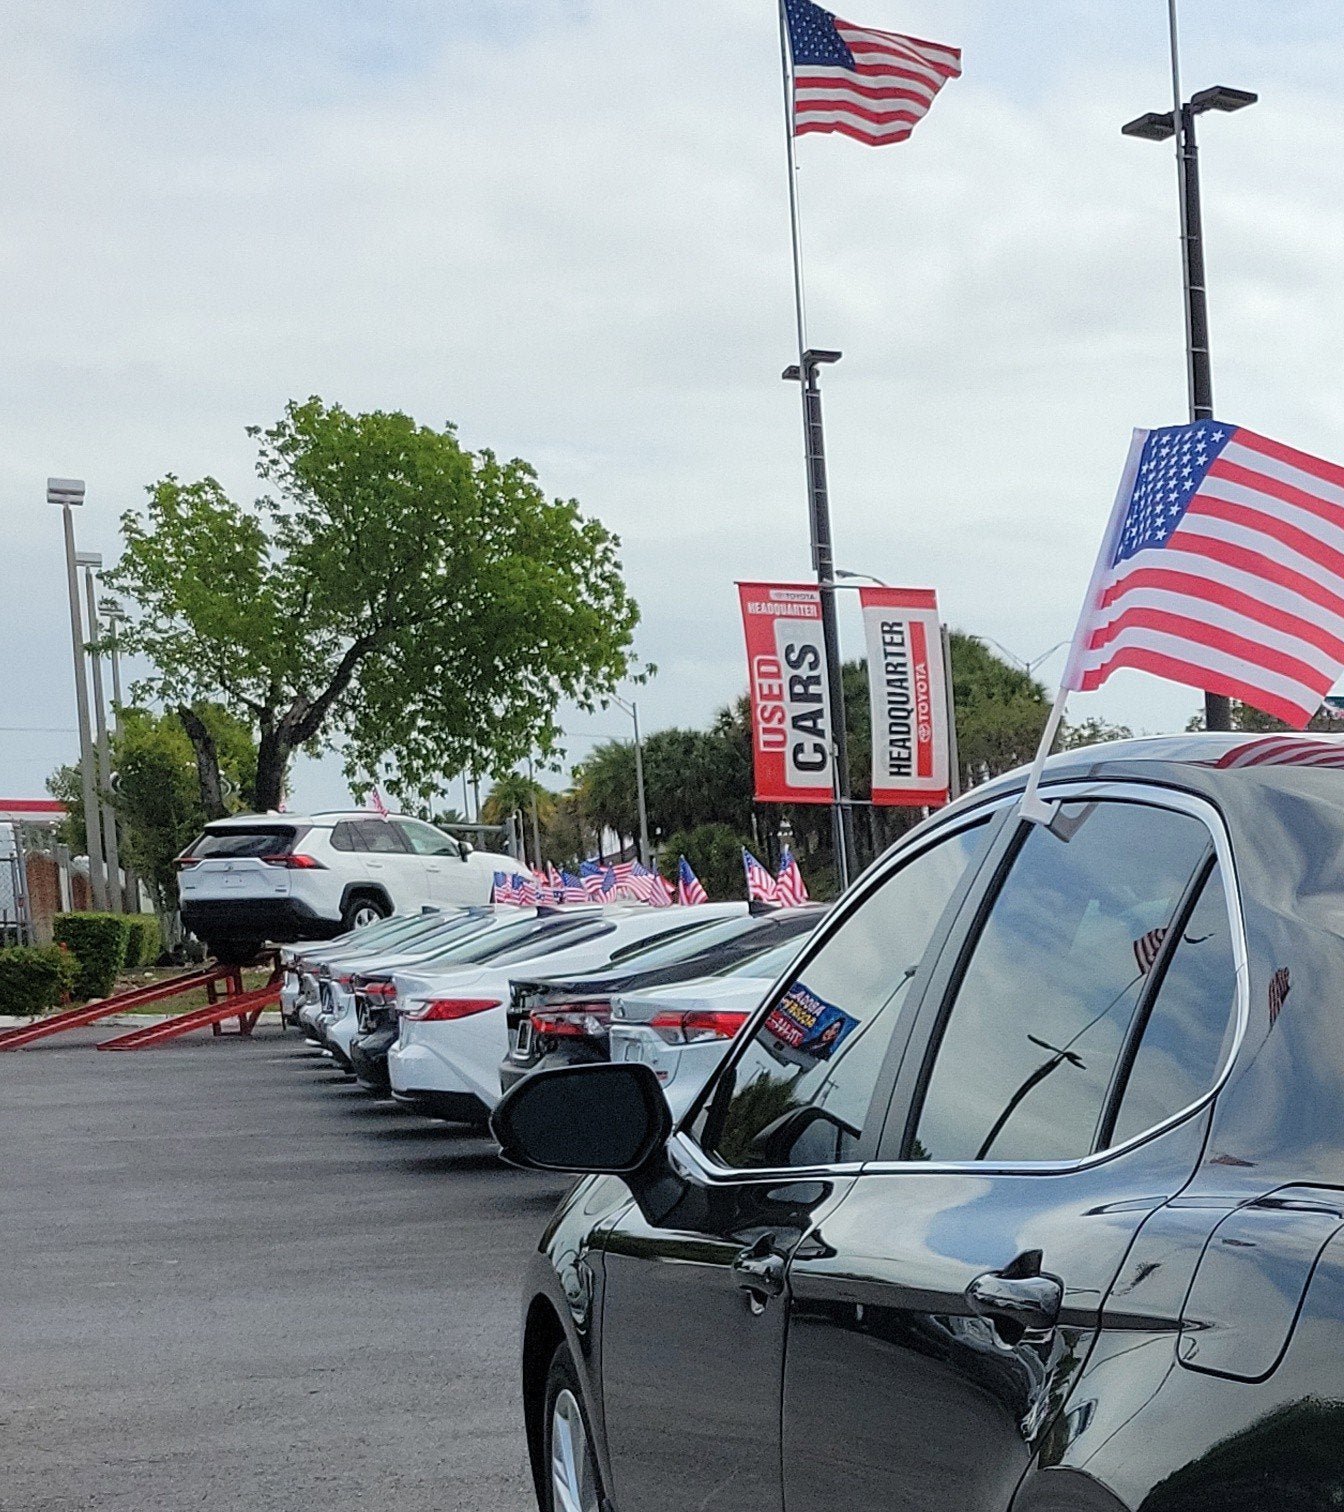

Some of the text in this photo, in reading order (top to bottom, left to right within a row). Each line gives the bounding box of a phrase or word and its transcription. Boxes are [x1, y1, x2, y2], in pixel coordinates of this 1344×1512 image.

[747, 602, 818, 617] HEADQUARTER
[754, 655, 787, 752] USED
[785, 643, 828, 772] CARS
[881, 621, 914, 778] HEADQUARTER
[915, 663, 931, 722] TOYOTA
